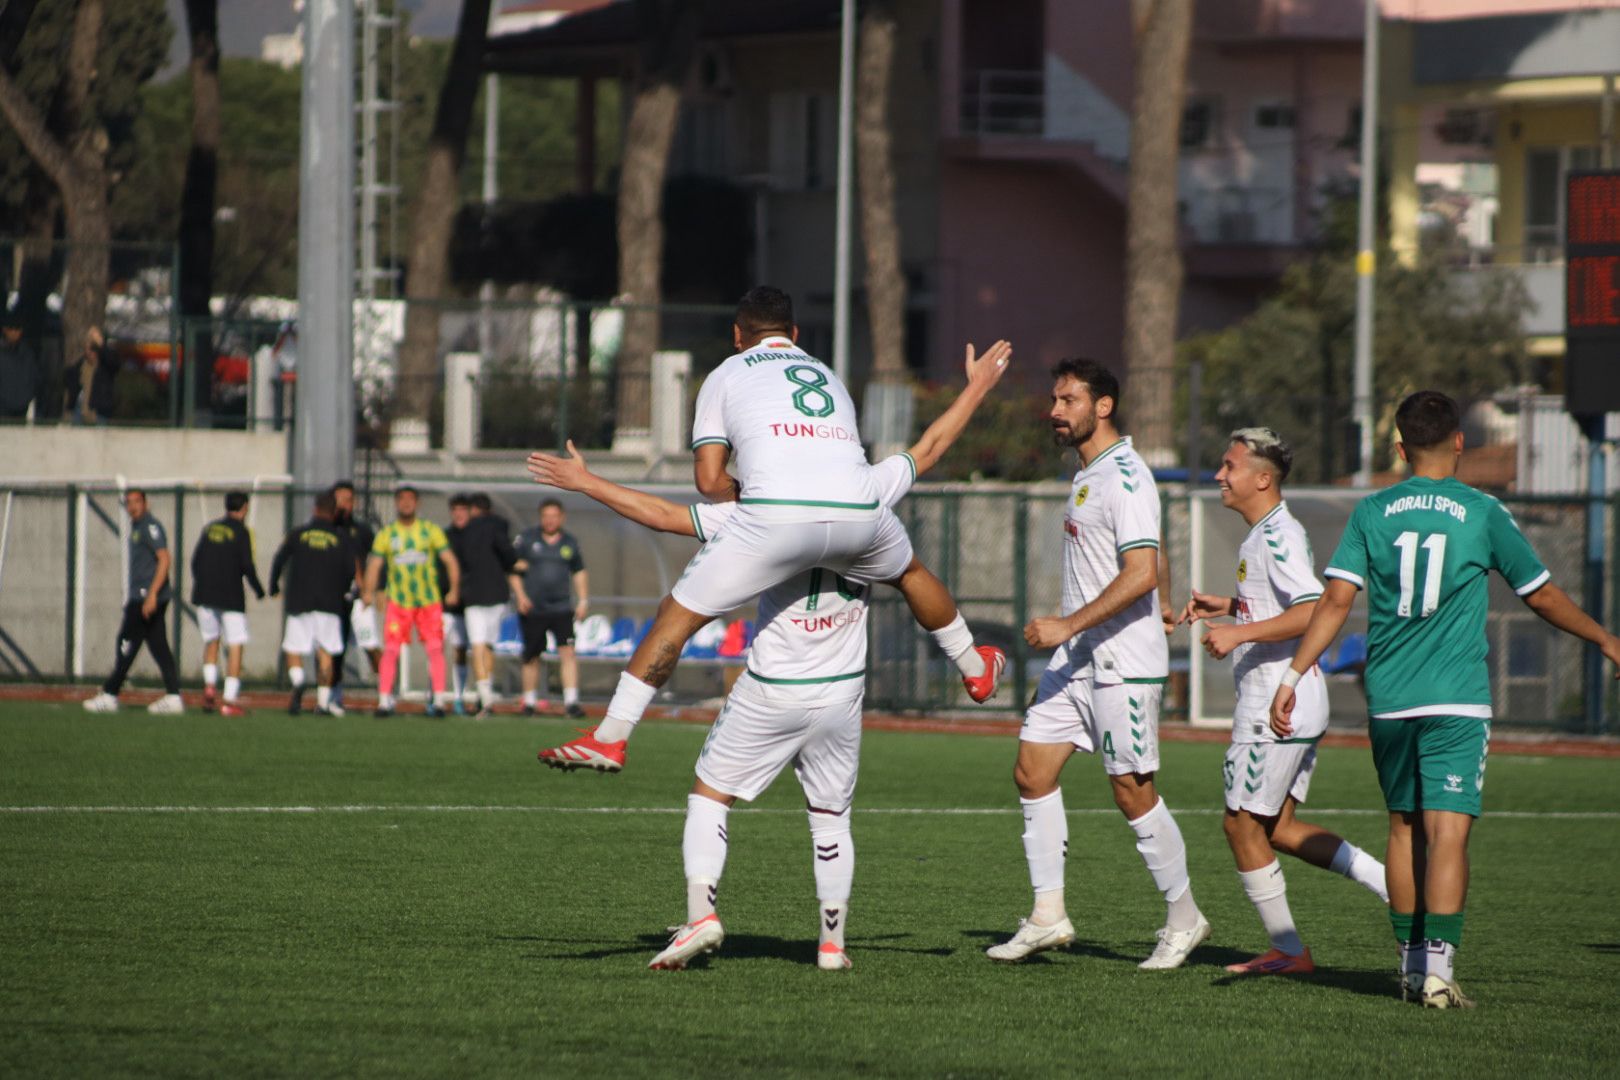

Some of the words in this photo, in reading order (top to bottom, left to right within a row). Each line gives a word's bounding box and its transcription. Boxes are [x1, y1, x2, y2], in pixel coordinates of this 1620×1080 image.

[784, 364, 836, 418] 8
[1384, 494, 1433, 518] MORALI
[1434, 495, 1466, 523] SPOR
[1393, 530, 1447, 618] 11
[1103, 730, 1117, 762] 4
